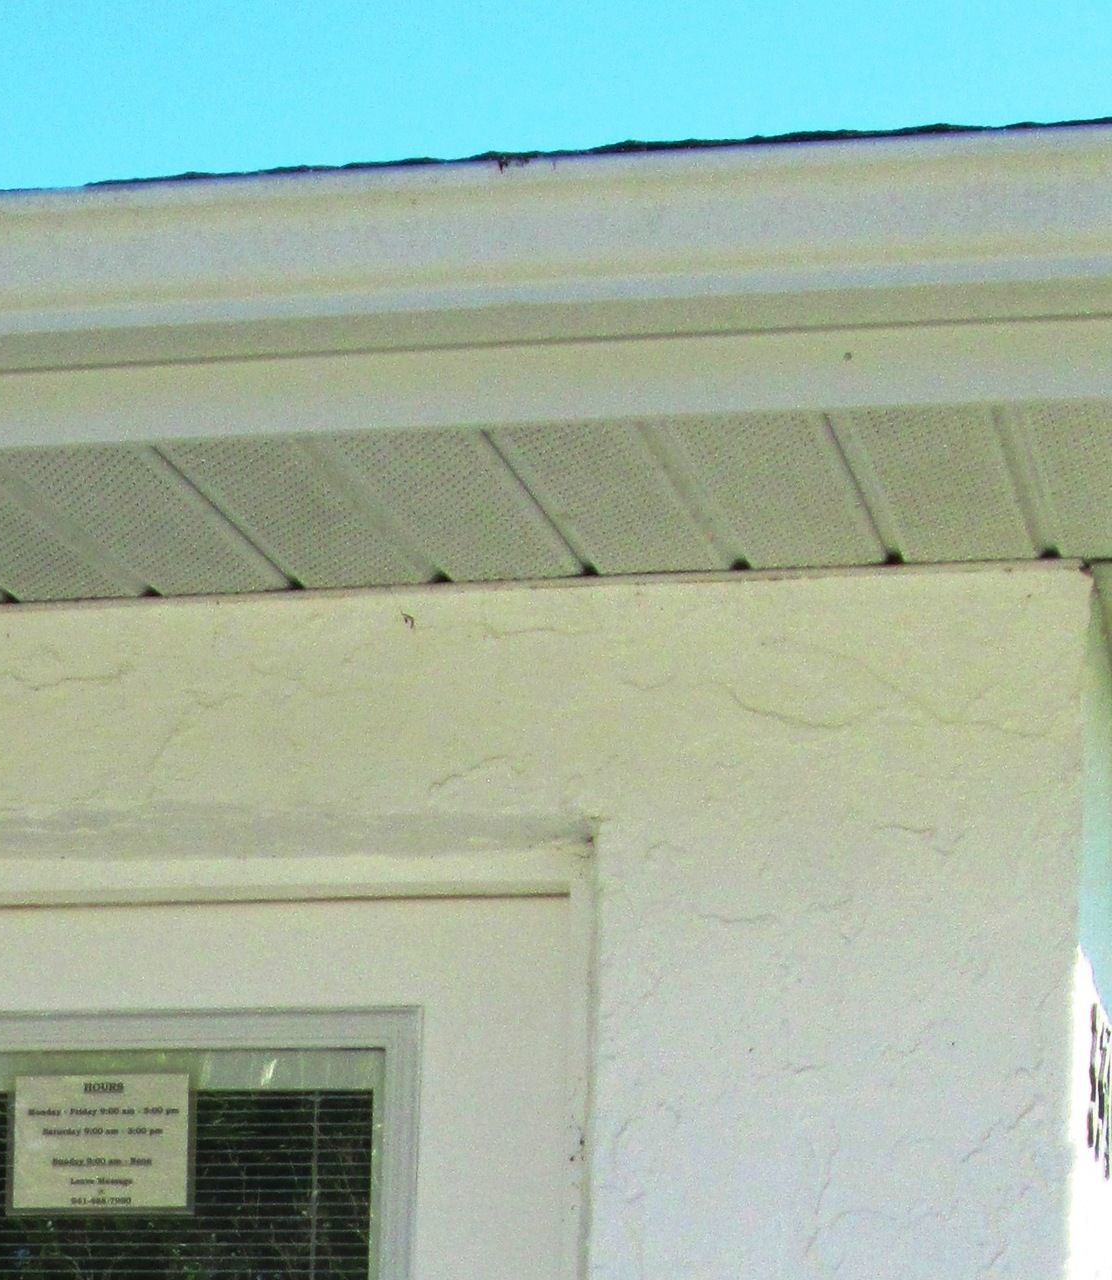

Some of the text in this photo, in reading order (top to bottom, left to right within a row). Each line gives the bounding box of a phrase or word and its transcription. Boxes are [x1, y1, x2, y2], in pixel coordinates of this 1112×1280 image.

[84, 1082, 124, 1093] HOURS
[28, 1108, 61, 1117] Monday
[70, 1107, 97, 1117] Friday
[100, 1107, 119, 1115] 9:00
[166, 1108, 179, 1117] pm
[42, 1127, 81, 1137] Saturday
[84, 1127, 103, 1136] 9:00
[149, 1129, 163, 1137] pm
[52, 1157, 84, 1167] Sunday
[70, 1177, 133, 1187] Leave Message
